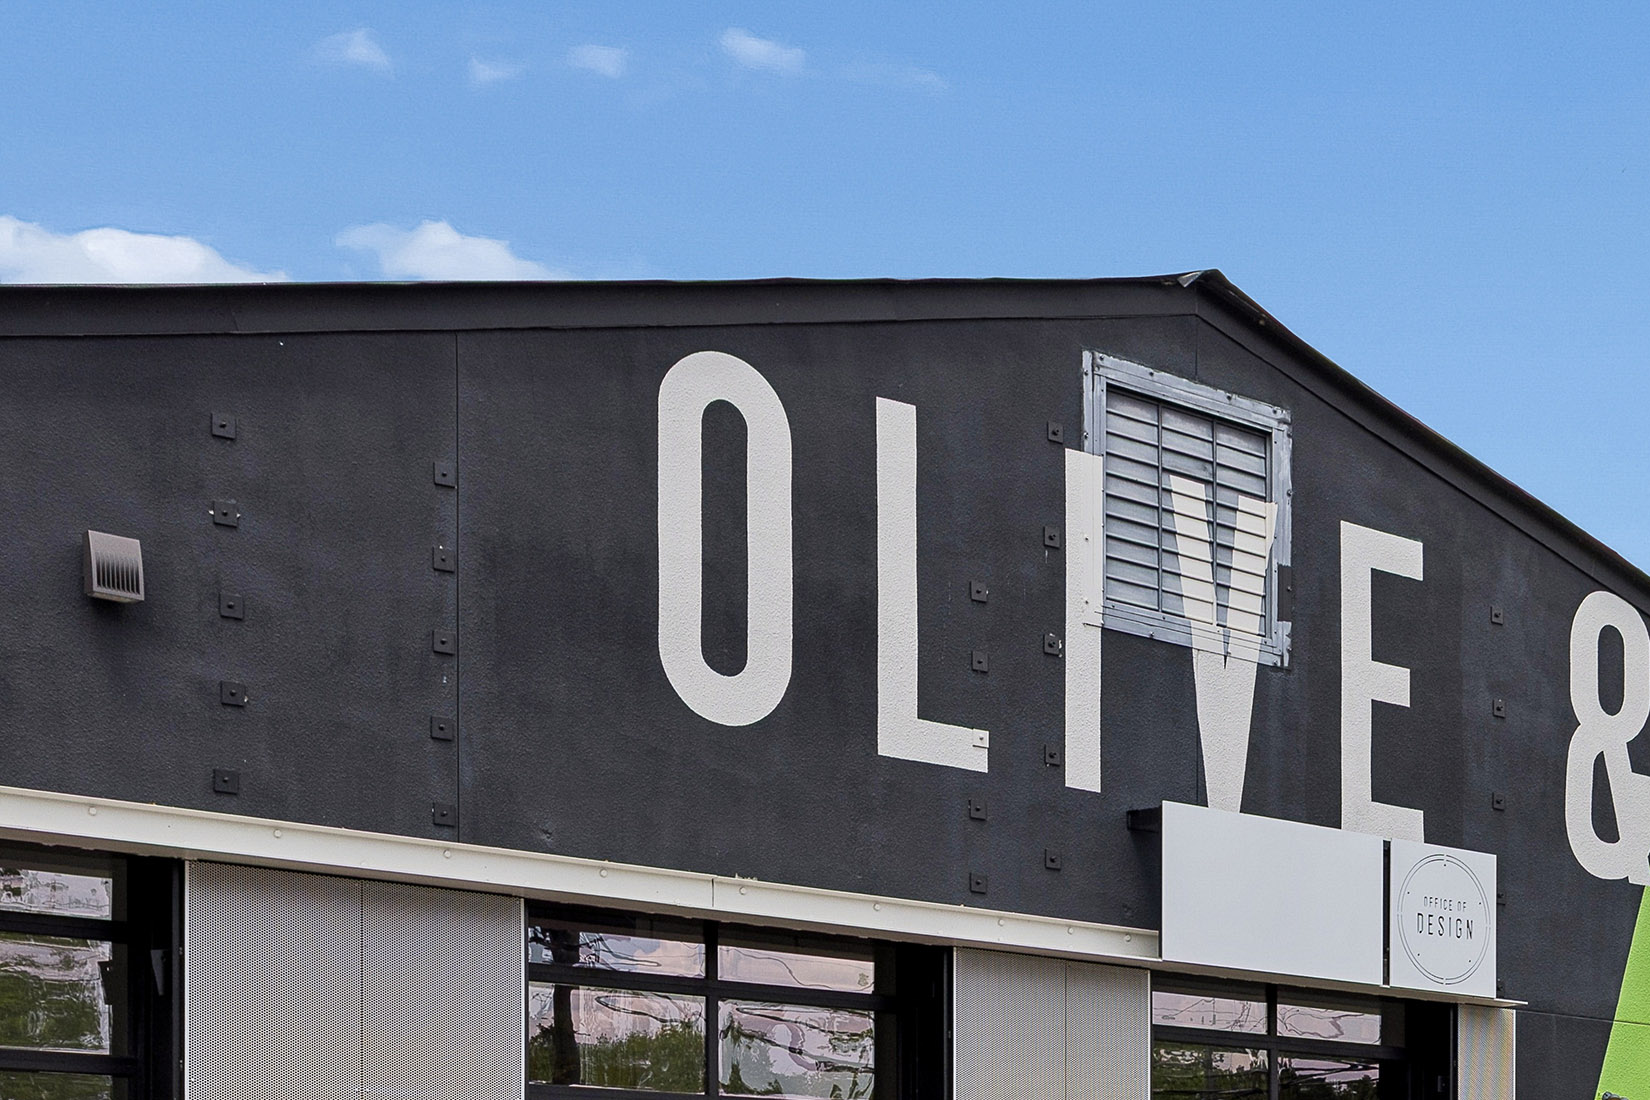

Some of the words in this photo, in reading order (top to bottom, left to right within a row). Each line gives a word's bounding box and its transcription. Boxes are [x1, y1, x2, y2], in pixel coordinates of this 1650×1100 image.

[658, 351, 1424, 843] OLIVE
[1423, 896, 1453, 912] OFFICE
[1457, 901, 1467, 912] OF
[1417, 913, 1474, 940] DESIGN
